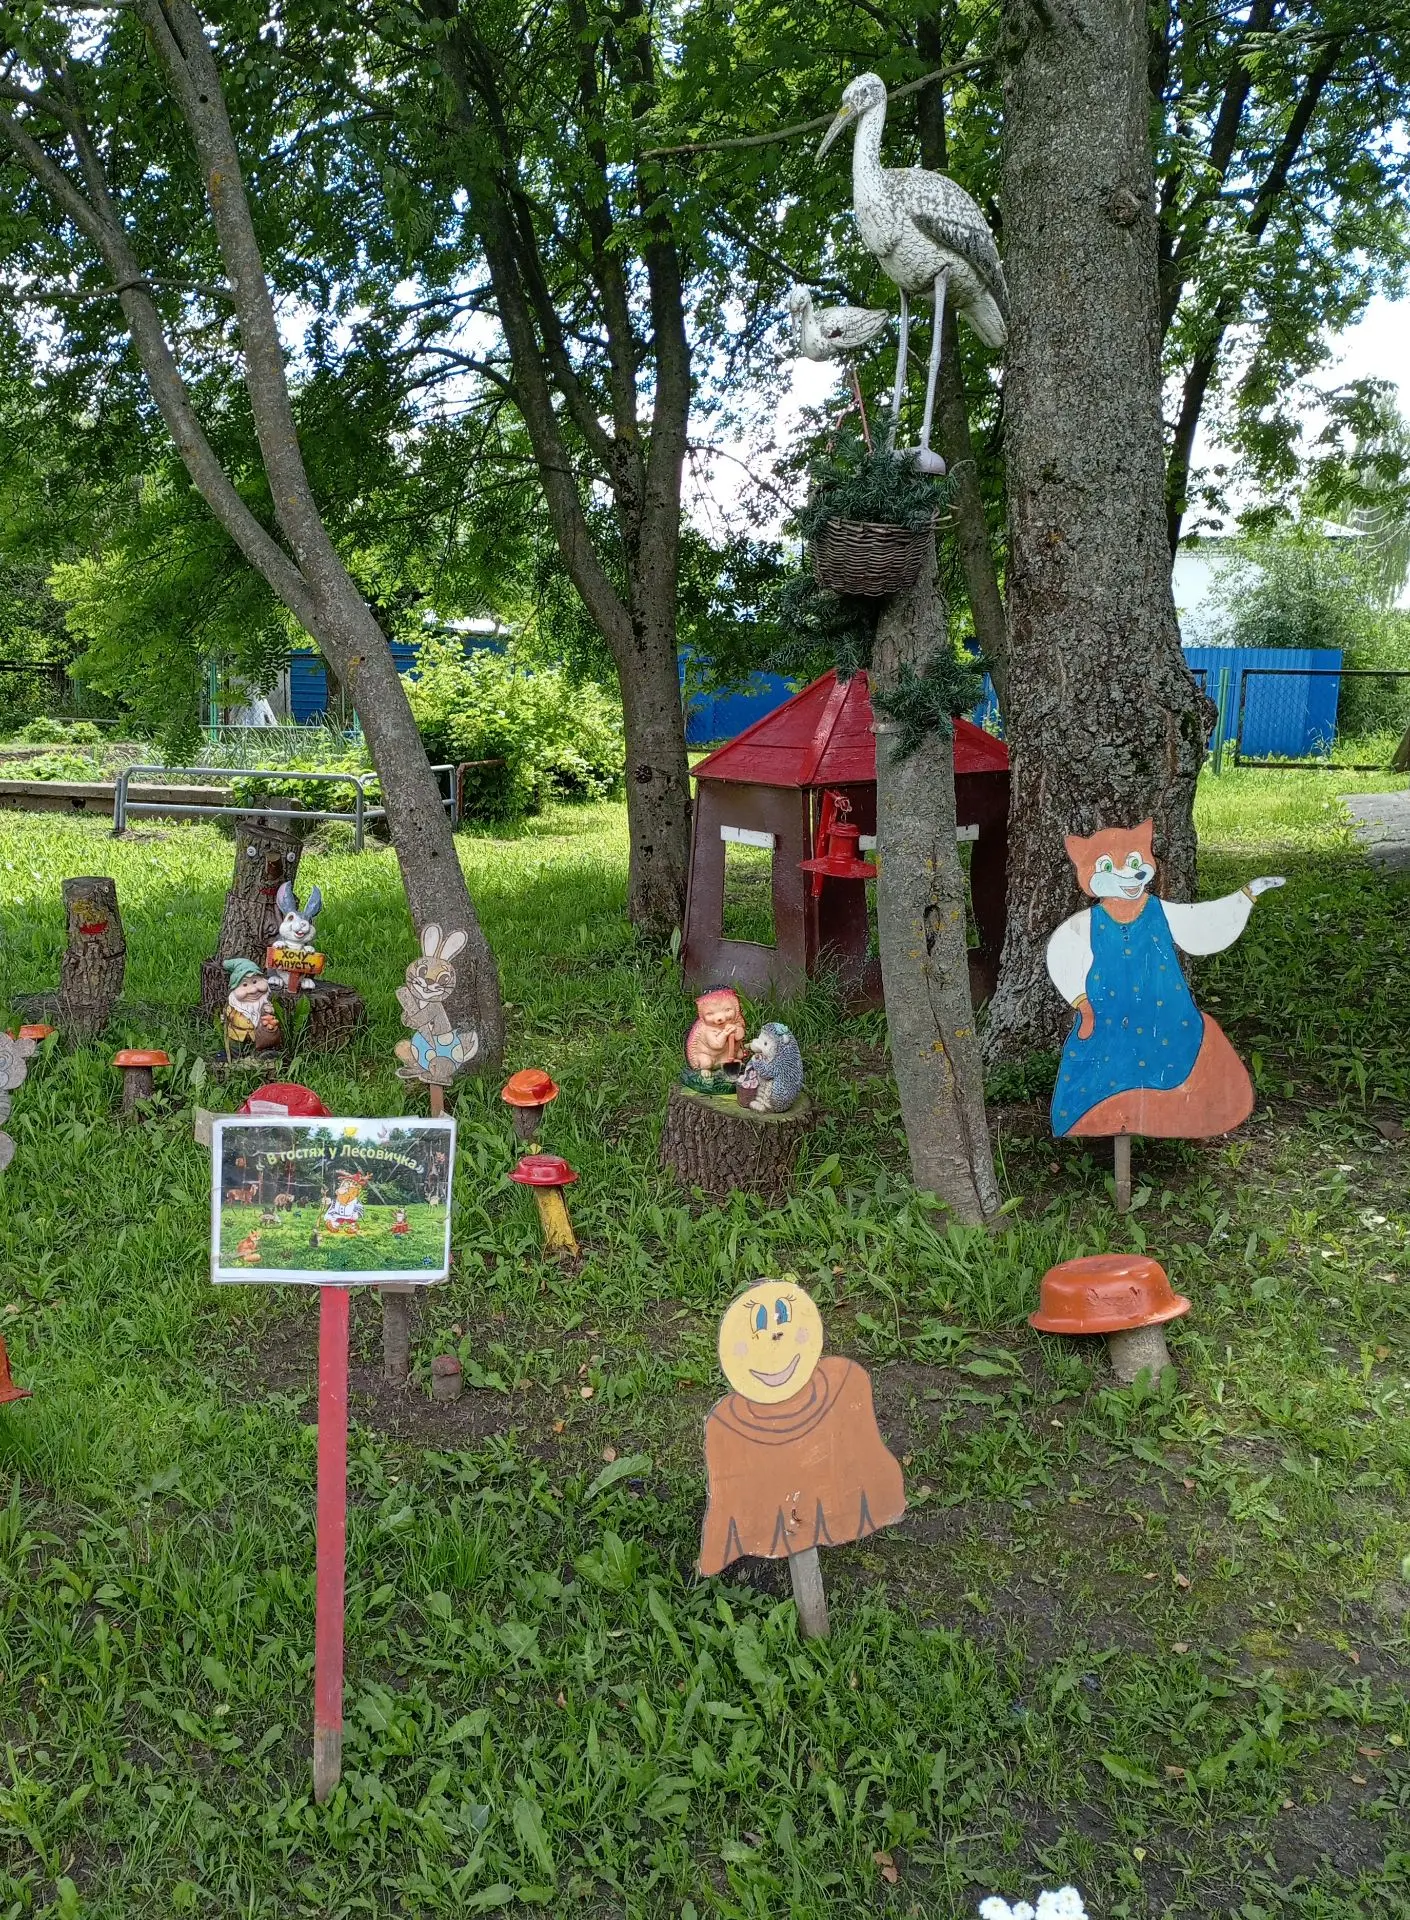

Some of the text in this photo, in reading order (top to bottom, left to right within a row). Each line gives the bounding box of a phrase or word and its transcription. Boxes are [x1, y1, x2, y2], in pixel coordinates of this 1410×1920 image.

[282, 950, 311, 961] ХОЧУ
[272, 959, 315, 970] КАПУСТУ
[280, 1147, 325, 1161] гостях
[329, 1147, 338, 1160] у
